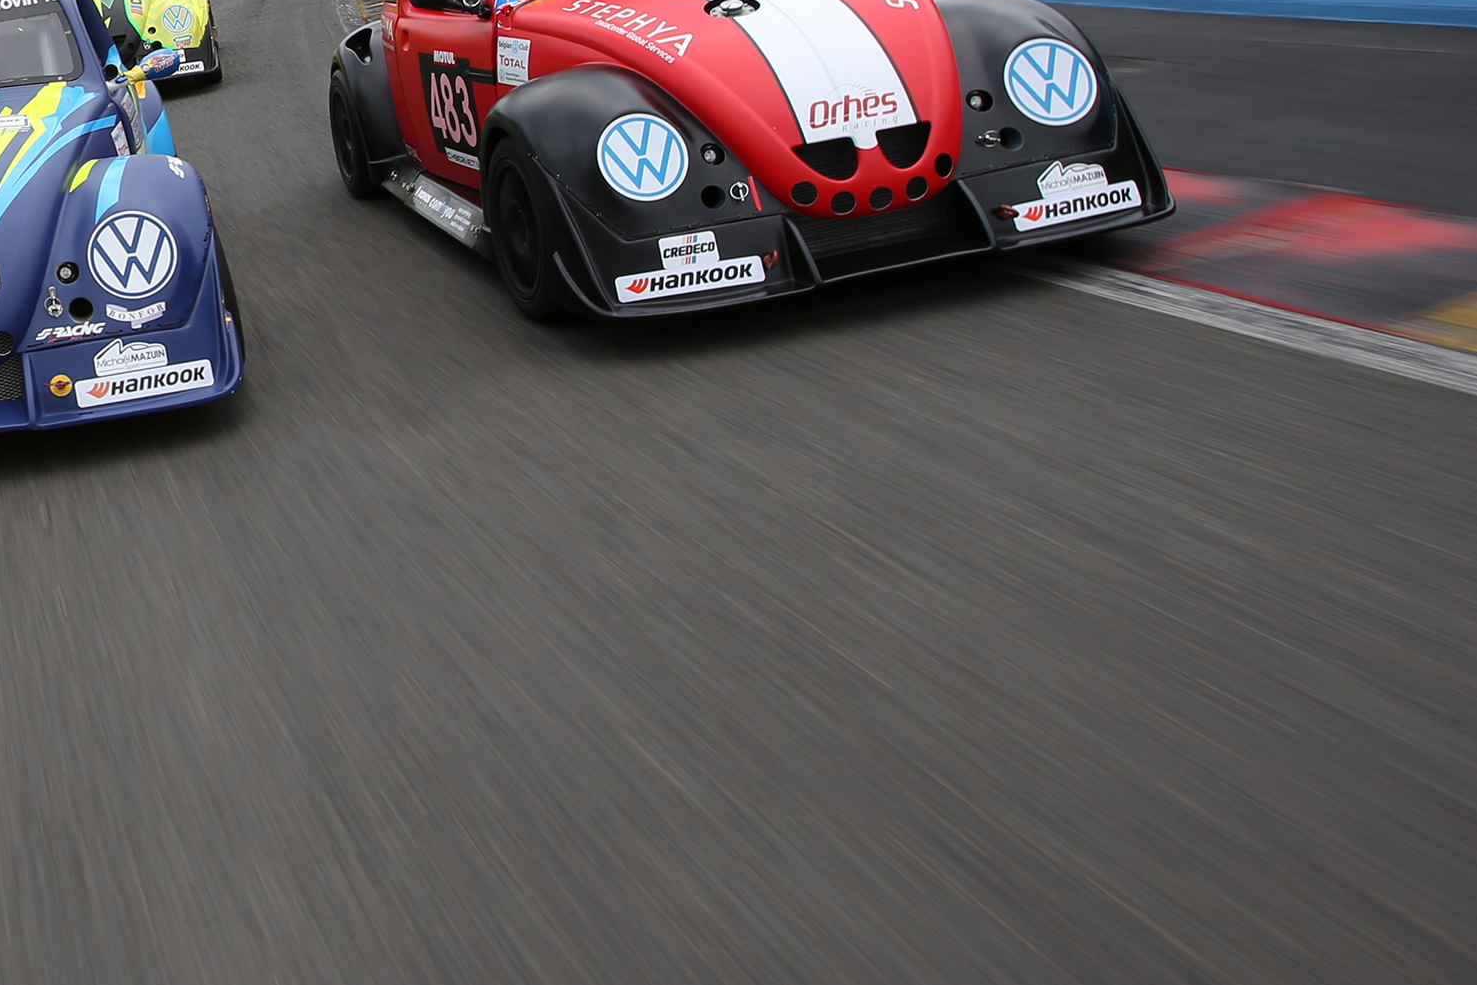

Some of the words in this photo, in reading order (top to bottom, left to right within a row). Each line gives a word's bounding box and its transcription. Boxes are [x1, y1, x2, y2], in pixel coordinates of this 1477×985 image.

[433, 49, 456, 65] MOTUL
[644, 41, 676, 64] Services
[179, 63, 201, 72] KOOK
[499, 54, 526, 70] TOTAL
[430, 72, 478, 148] 483
[841, 115, 898, 133] Racing
[662, 241, 716, 260] CREDECO
[108, 303, 164, 321] BONFOR
